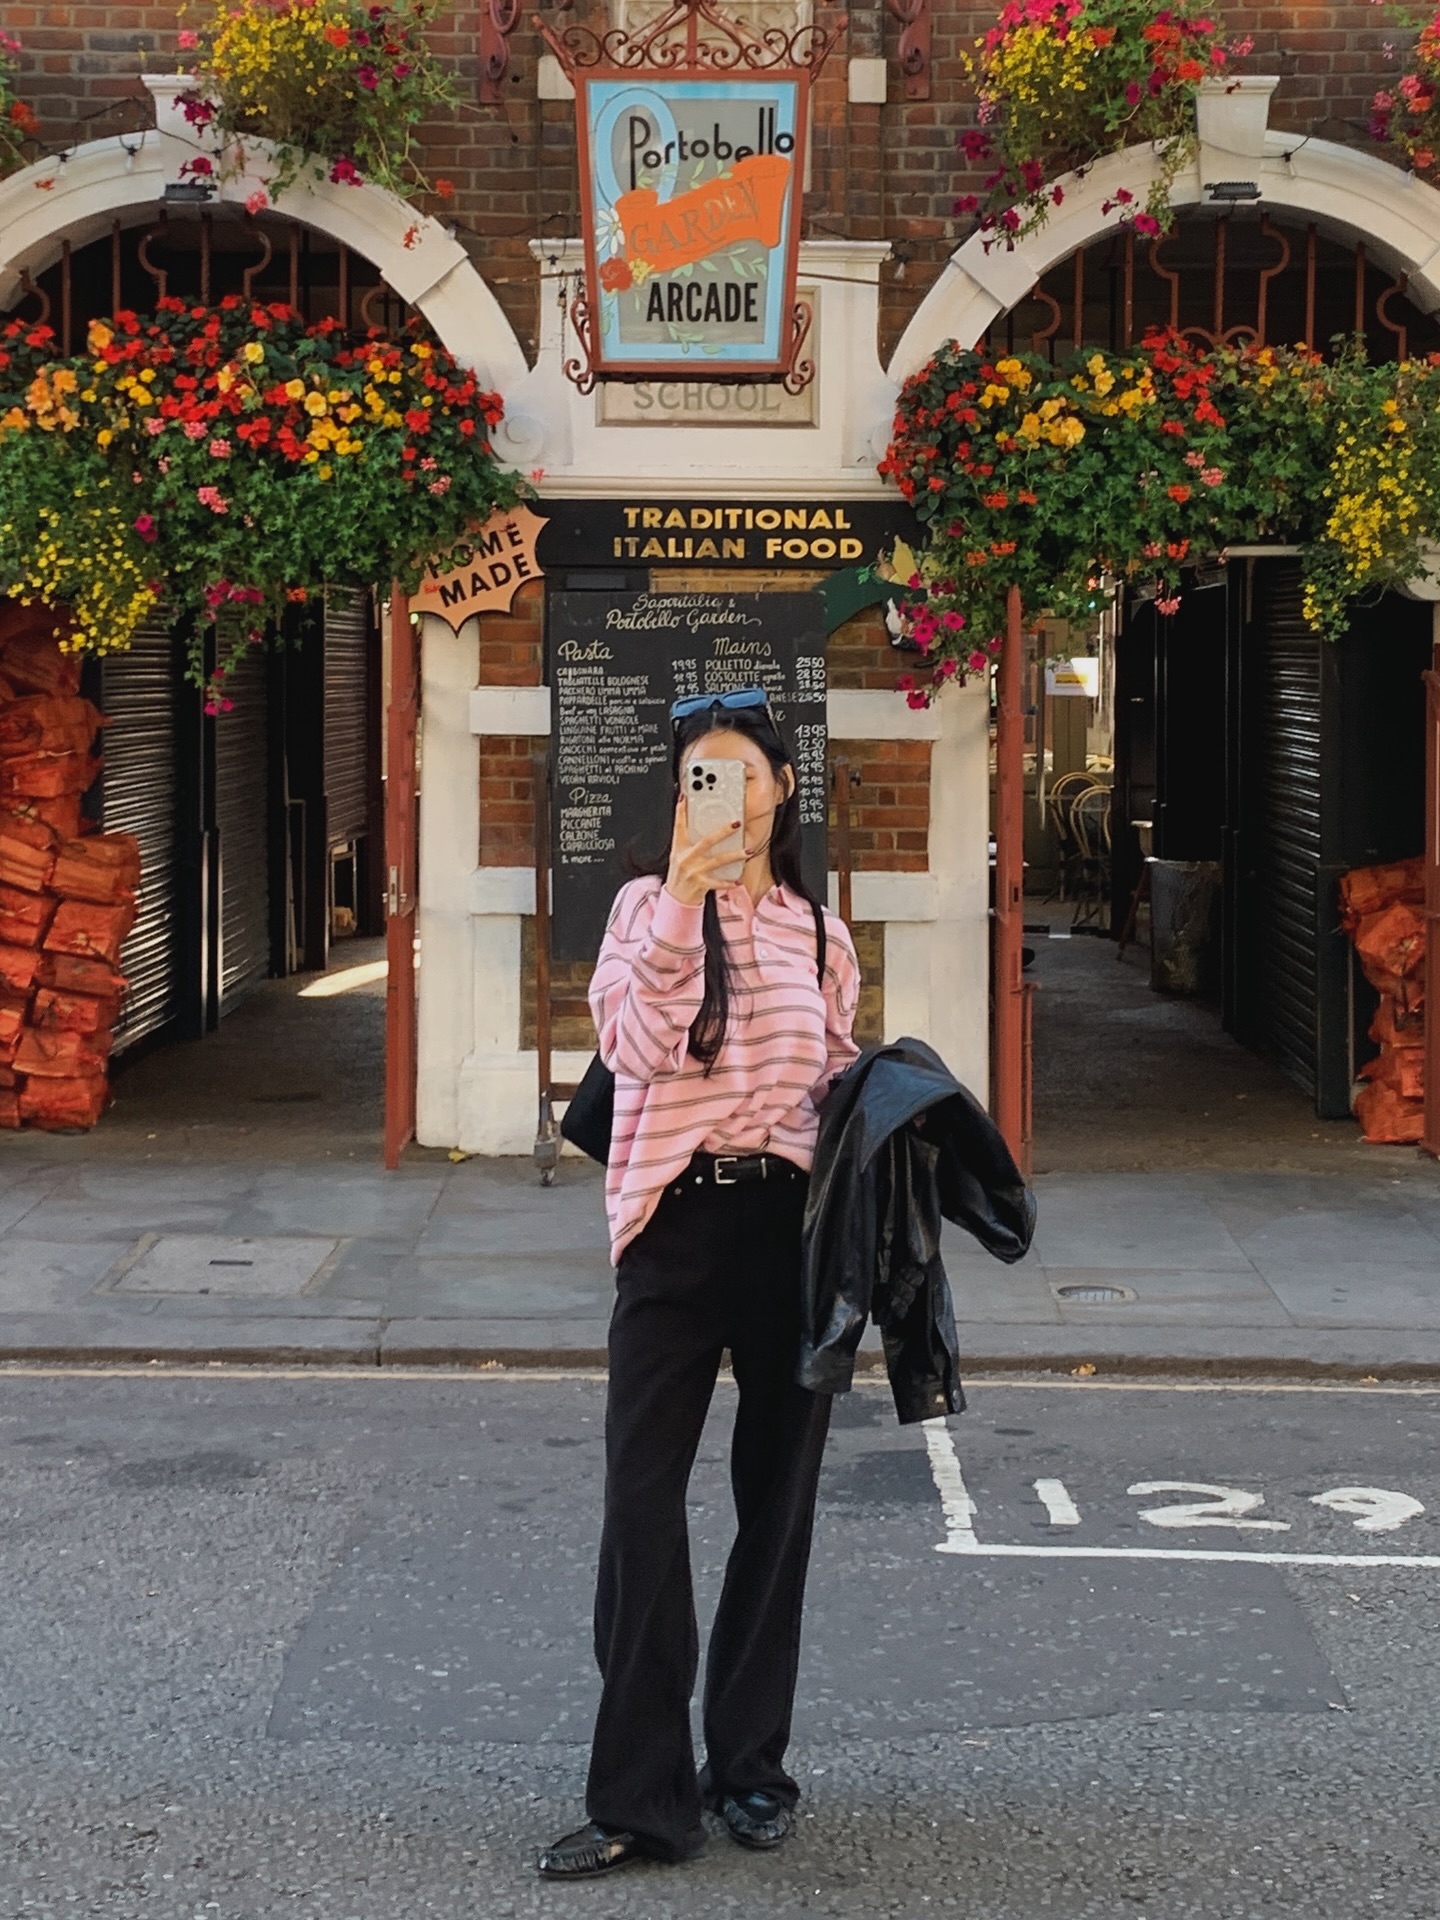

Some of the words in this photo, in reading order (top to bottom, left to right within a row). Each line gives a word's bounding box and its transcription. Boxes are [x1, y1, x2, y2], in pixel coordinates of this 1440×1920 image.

[629, 107, 795, 190] Portobello
[630, 175, 758, 254] GARDEN
[646, 282, 758, 323] ARCADE
[633, 382, 781, 411] SCHOOL
[624, 507, 851, 529] TRADITIONAL
[427, 522, 524, 579] HOME
[613, 537, 745, 559] ITALIAN
[766, 538, 864, 559] FOOD
[438, 552, 531, 608] MADE
[605, 608, 685, 630] Portobello
[686, 609, 762, 634] Garden
[558, 639, 614, 662] Pasta
[713, 636, 772, 656] Mains
[705, 658, 752, 671] POLLETTO
[607, 675, 649, 686] BOLOGNESE
[704, 670, 760, 682] COSTOLETTE
[559, 686, 596, 695] PACCHERO
[559, 696, 607, 705] PAPPARDELLE
[599, 706, 635, 716] LASAGNA
[560, 715, 602, 726] SPAGHETTI
[603, 715, 639, 725] VONGOLE
[559, 725, 597, 735] LINGUINE
[600, 725, 627, 735] FRUTTI
[638, 724, 658, 734] MARE
[560, 734, 595, 744] RIGATONI
[612, 734, 644, 744] NORMA
[559, 745, 597, 754] GNOCCHI
[558, 755, 610, 765] CANNELLONI
[559, 764, 602, 774] SPAGHETTI
[614, 764, 649, 774] PACHINO
[560, 775, 586, 785] VEGAN
[587, 775, 620, 784] RAVIOLI
[569, 787, 613, 805] Pizza
[561, 806, 612, 818] MARGHERITA
[561, 817, 602, 830] PICCANTE
[560, 829, 600, 840] CALZONE
[560, 838, 615, 852] CAPRICCIOSA
